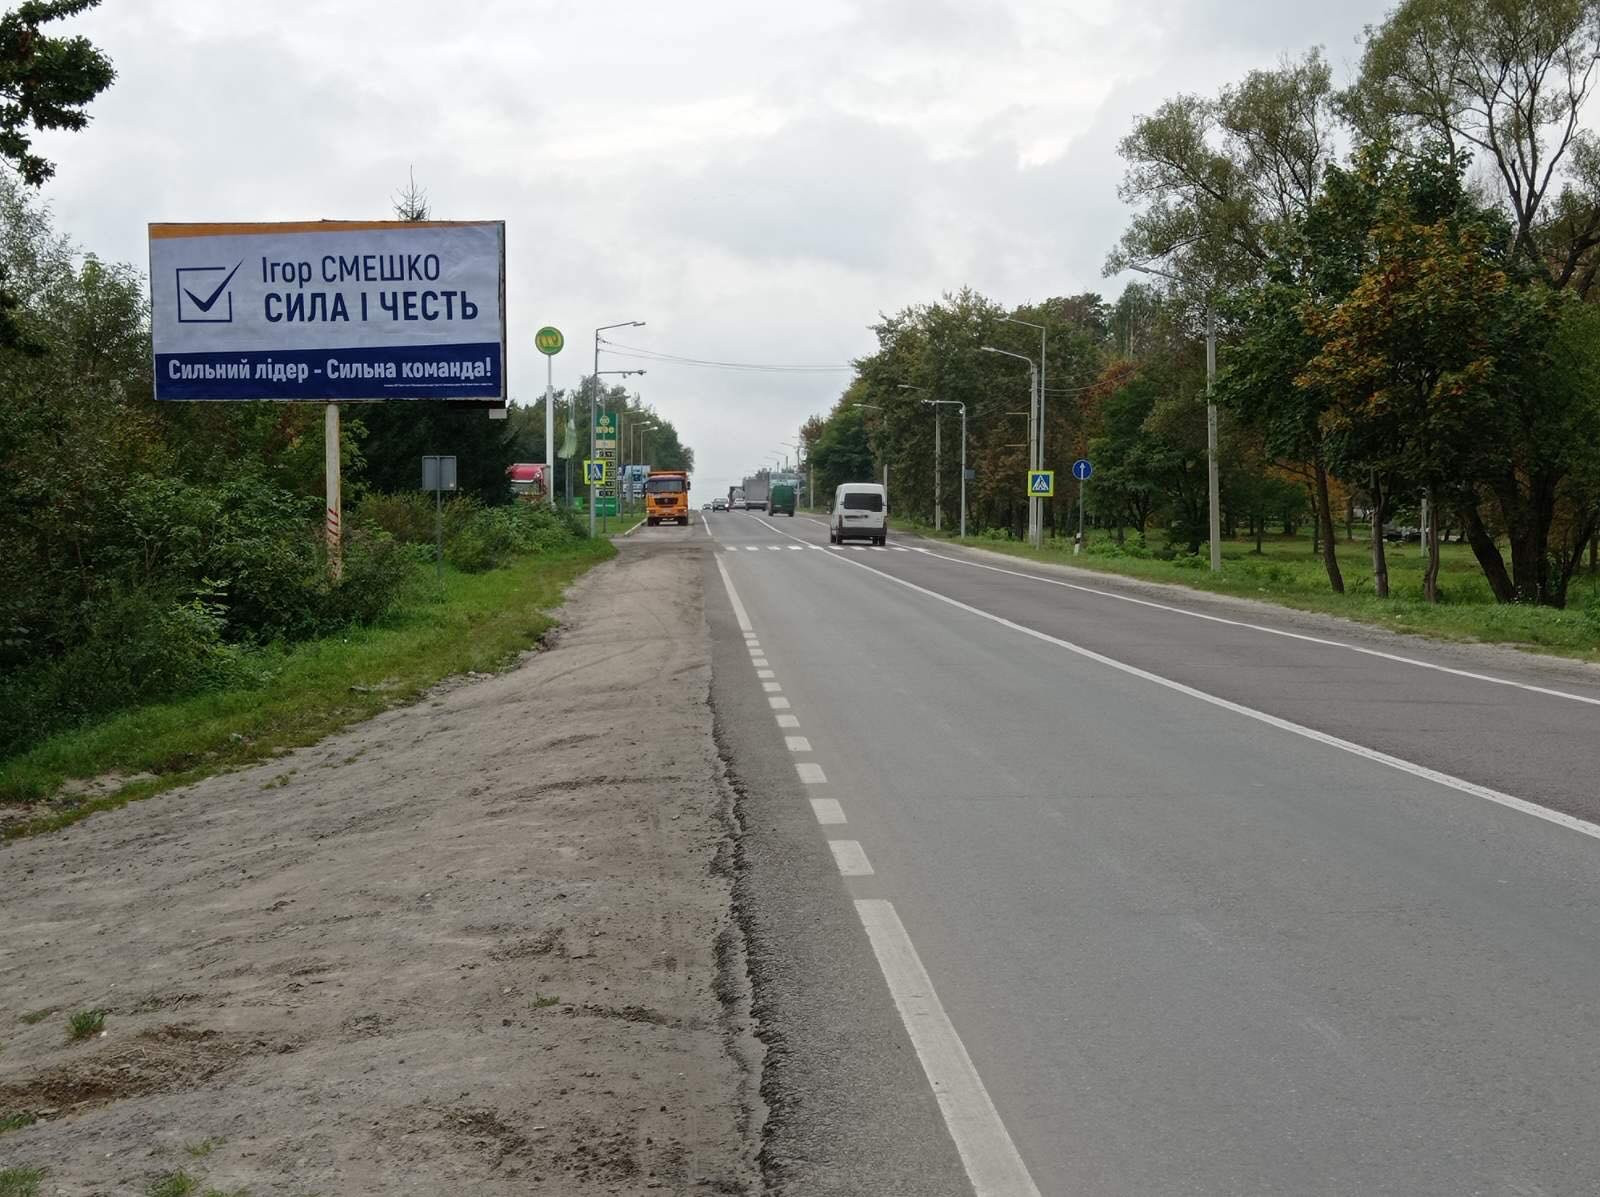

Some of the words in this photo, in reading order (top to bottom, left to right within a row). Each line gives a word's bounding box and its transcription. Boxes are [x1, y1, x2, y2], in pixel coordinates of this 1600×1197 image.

[262, 256, 312, 288] Ігор
[321, 254, 440, 282] СМЕШКО
[264, 292, 350, 322] СИЛА
[360, 292, 368, 321] І
[380, 291, 479, 321] ЧЕСТЬ
[168, 358, 250, 379] Сильний
[255, 358, 309, 383] лідер
[326, 358, 397, 379] Сильна
[402, 357, 492, 380] команда!
